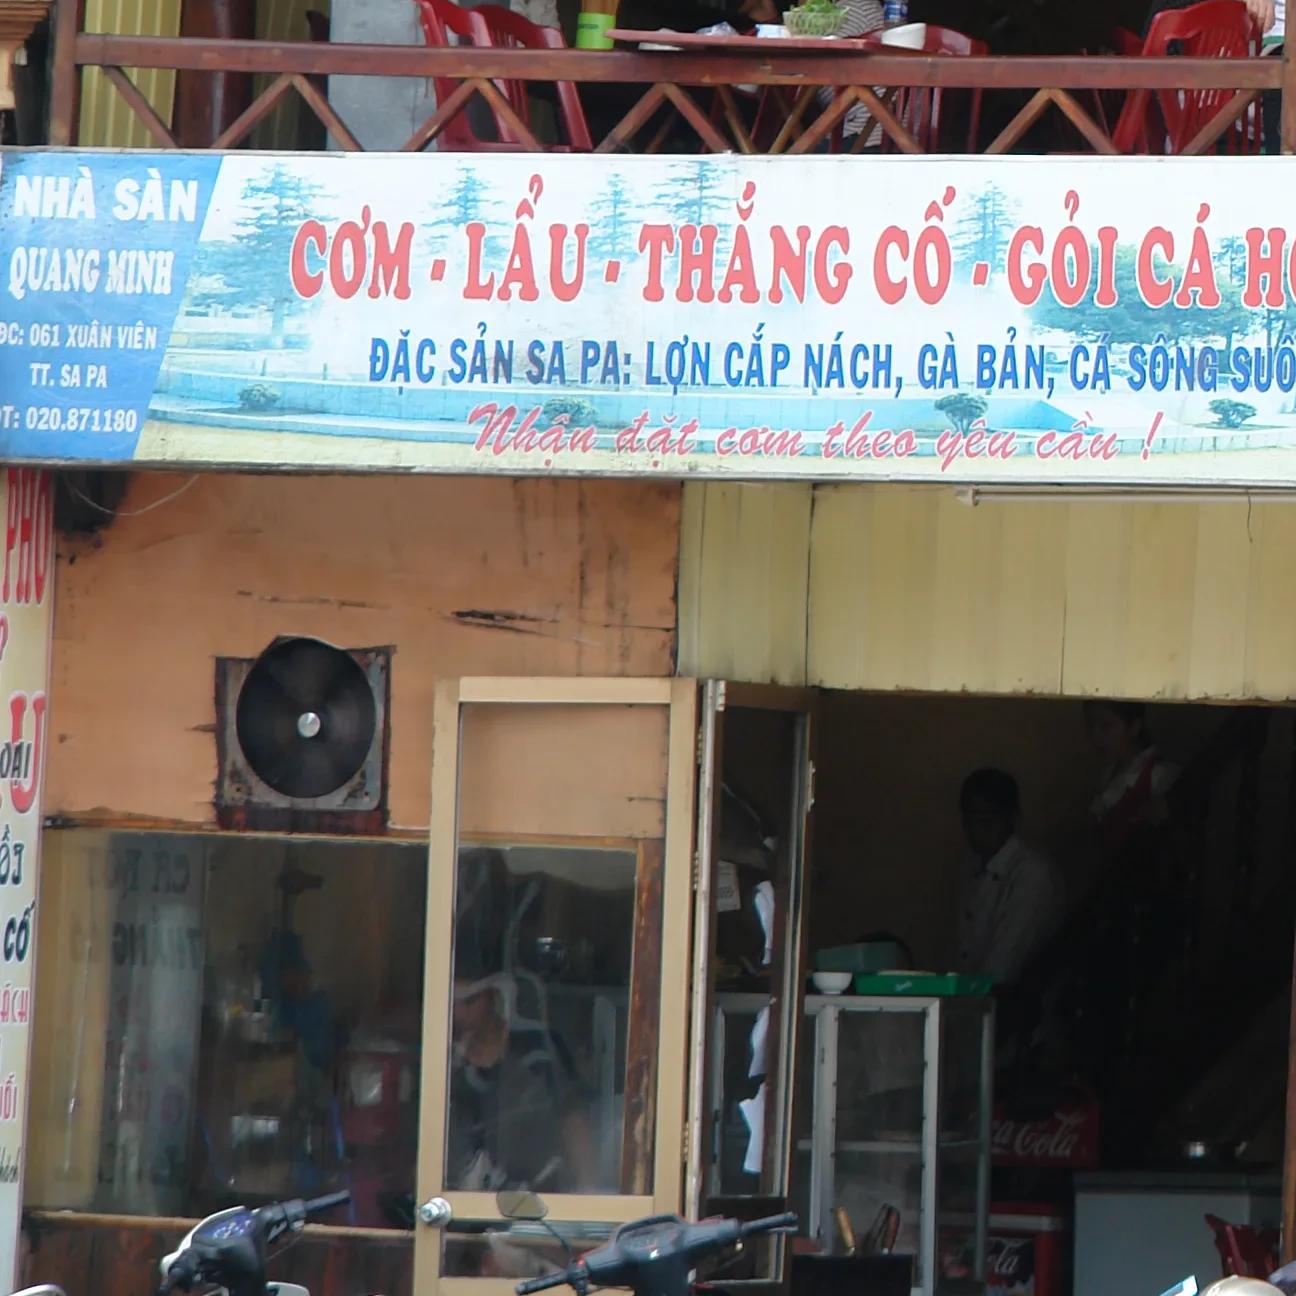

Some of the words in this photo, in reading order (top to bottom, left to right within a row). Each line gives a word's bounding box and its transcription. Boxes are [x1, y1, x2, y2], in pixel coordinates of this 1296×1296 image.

[14, 167, 97, 220] NHÀ
[112, 168, 199, 223] SÀN
[290, 204, 416, 301] CƠM
[462, 173, 591, 302] LẨU
[638, 180, 854, 304] THẮNG
[872, 185, 957, 306] CỐ
[1007, 189, 1119, 307] GỎI
[1136, 202, 1221, 308] CÁ
[8, 246, 101, 301] QUANG
[105, 249, 175, 296] MINH
[29, 323, 60, 347] 061
[65, 319, 112, 349] XUÂN
[117, 319, 158, 350] VIÊN
[369, 329, 437, 396] ĐẶC
[448, 321, 514, 384] SẢN
[525, 340, 567, 385] SA
[580, 340, 633, 386] PA:
[645, 334, 712, 396] LỢN
[723, 322, 791, 388] CẮP
[803, 331, 903, 399] NÁCH,
[917, 331, 960, 389] GÀ
[976, 325, 1055, 399] BẢN,
[1070, 332, 1112, 391] CÁ
[1127, 333, 1219, 393] SÔNG
[30, 362, 55, 387] TT.
[60, 365, 81, 388] SA
[86, 365, 108, 388] PA
[25, 406, 138, 433] 020.871180
[468, 402, 599, 467] Nhận
[615, 410, 700, 468] đặt
[715, 425, 807, 458] cơm
[821, 410, 918, 459] theo
[934, 419, 1020, 473] yêu
[1034, 410, 1121, 461] cầu
